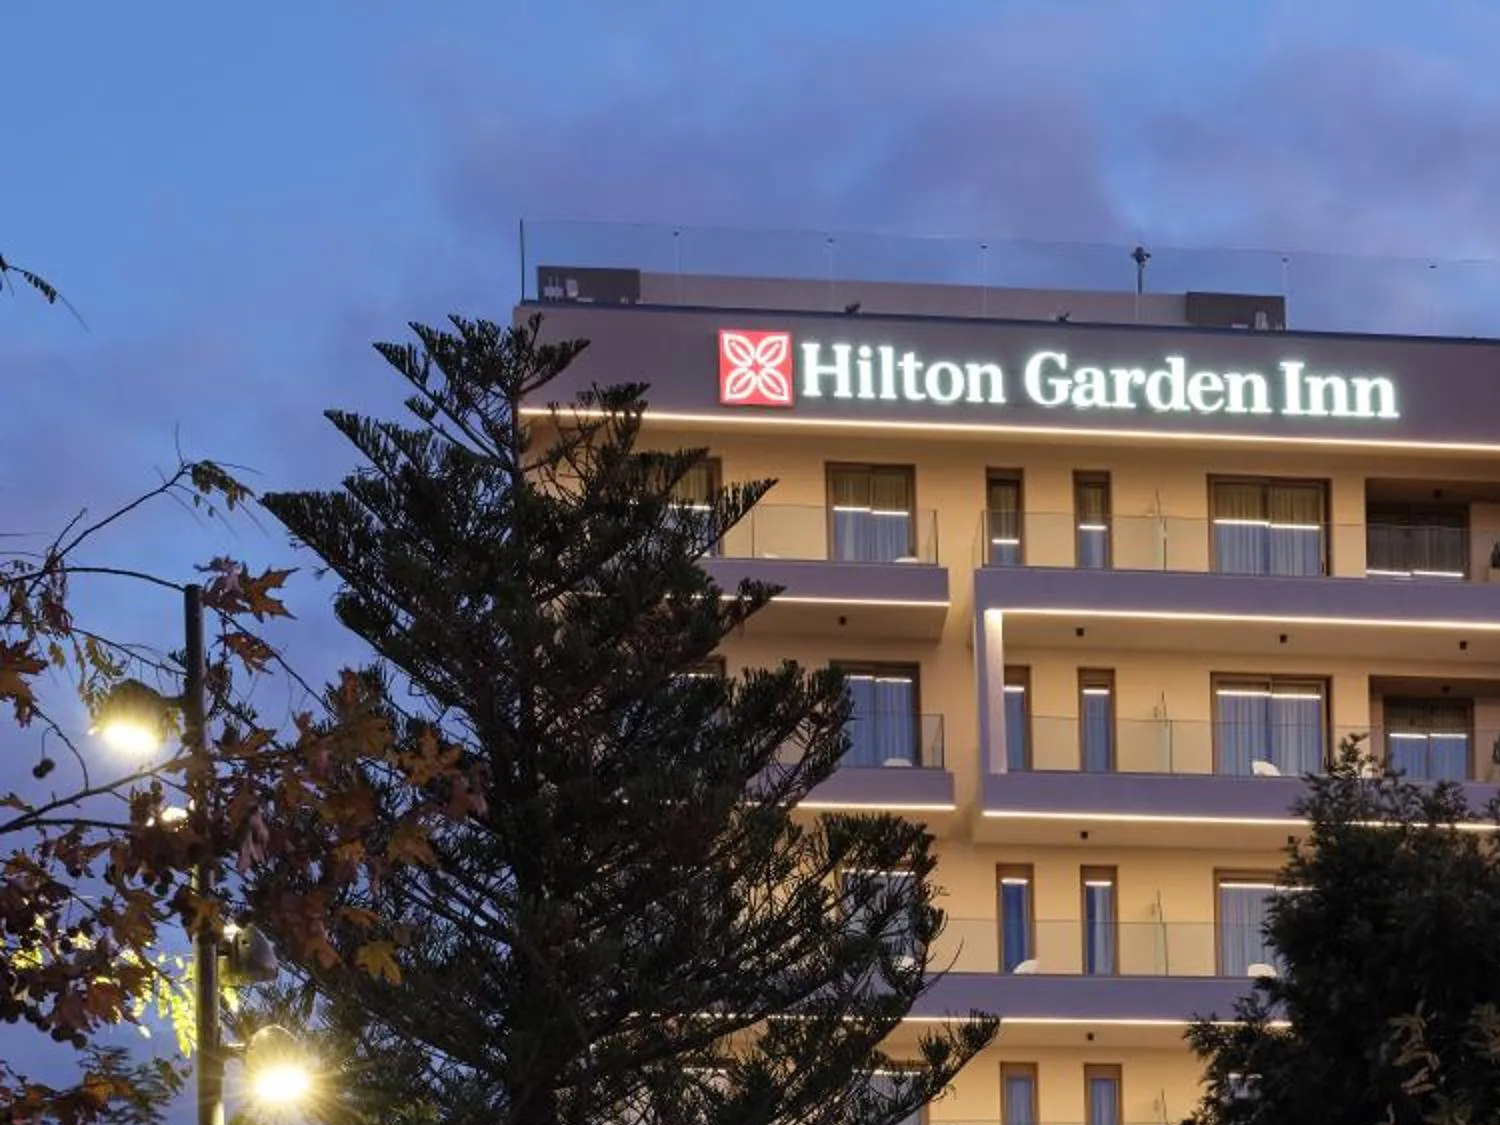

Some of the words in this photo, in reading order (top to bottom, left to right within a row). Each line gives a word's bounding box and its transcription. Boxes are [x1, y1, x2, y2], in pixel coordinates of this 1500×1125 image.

[800, 342, 1006, 404] Hilton
[1024, 351, 1273, 415] Garden
[1279, 360, 1400, 418] Inn
